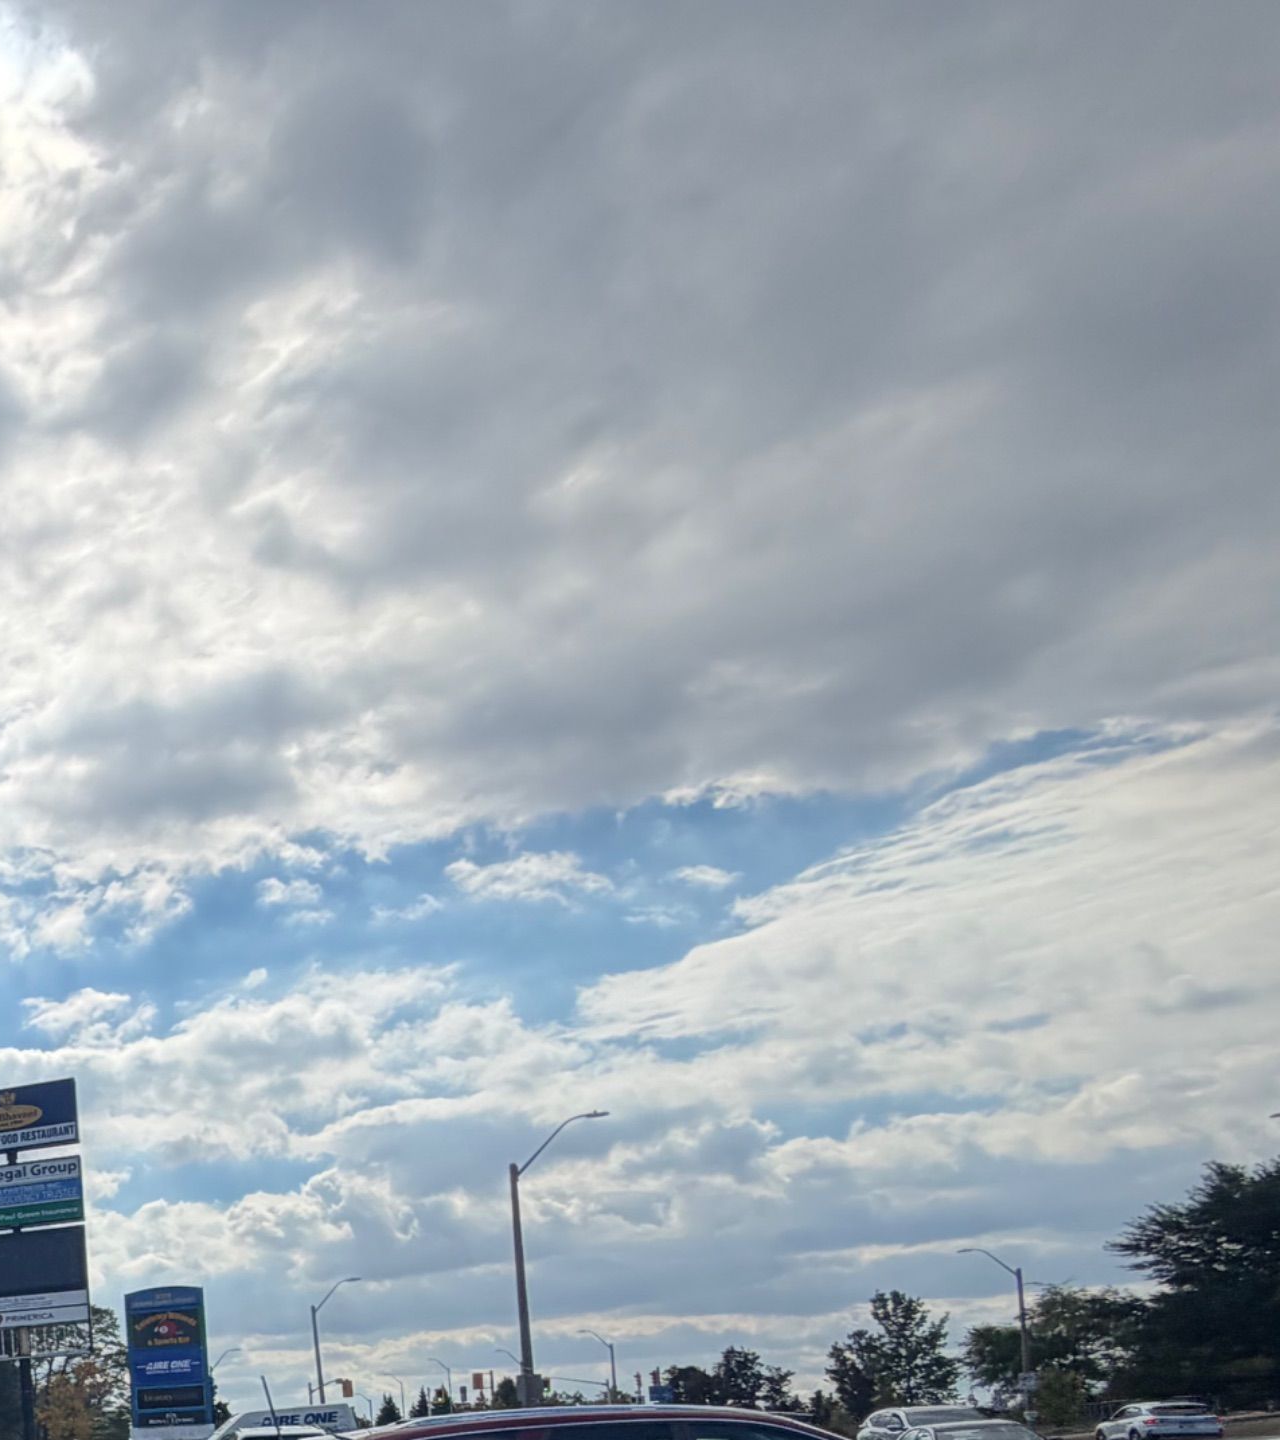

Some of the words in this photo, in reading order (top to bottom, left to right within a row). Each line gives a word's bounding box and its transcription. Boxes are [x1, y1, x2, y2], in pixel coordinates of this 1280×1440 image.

[20, 1125, 75, 1141] RESTAURANT
[30, 1162, 77, 1177] Group
[304, 1411, 339, 1425] ONE
